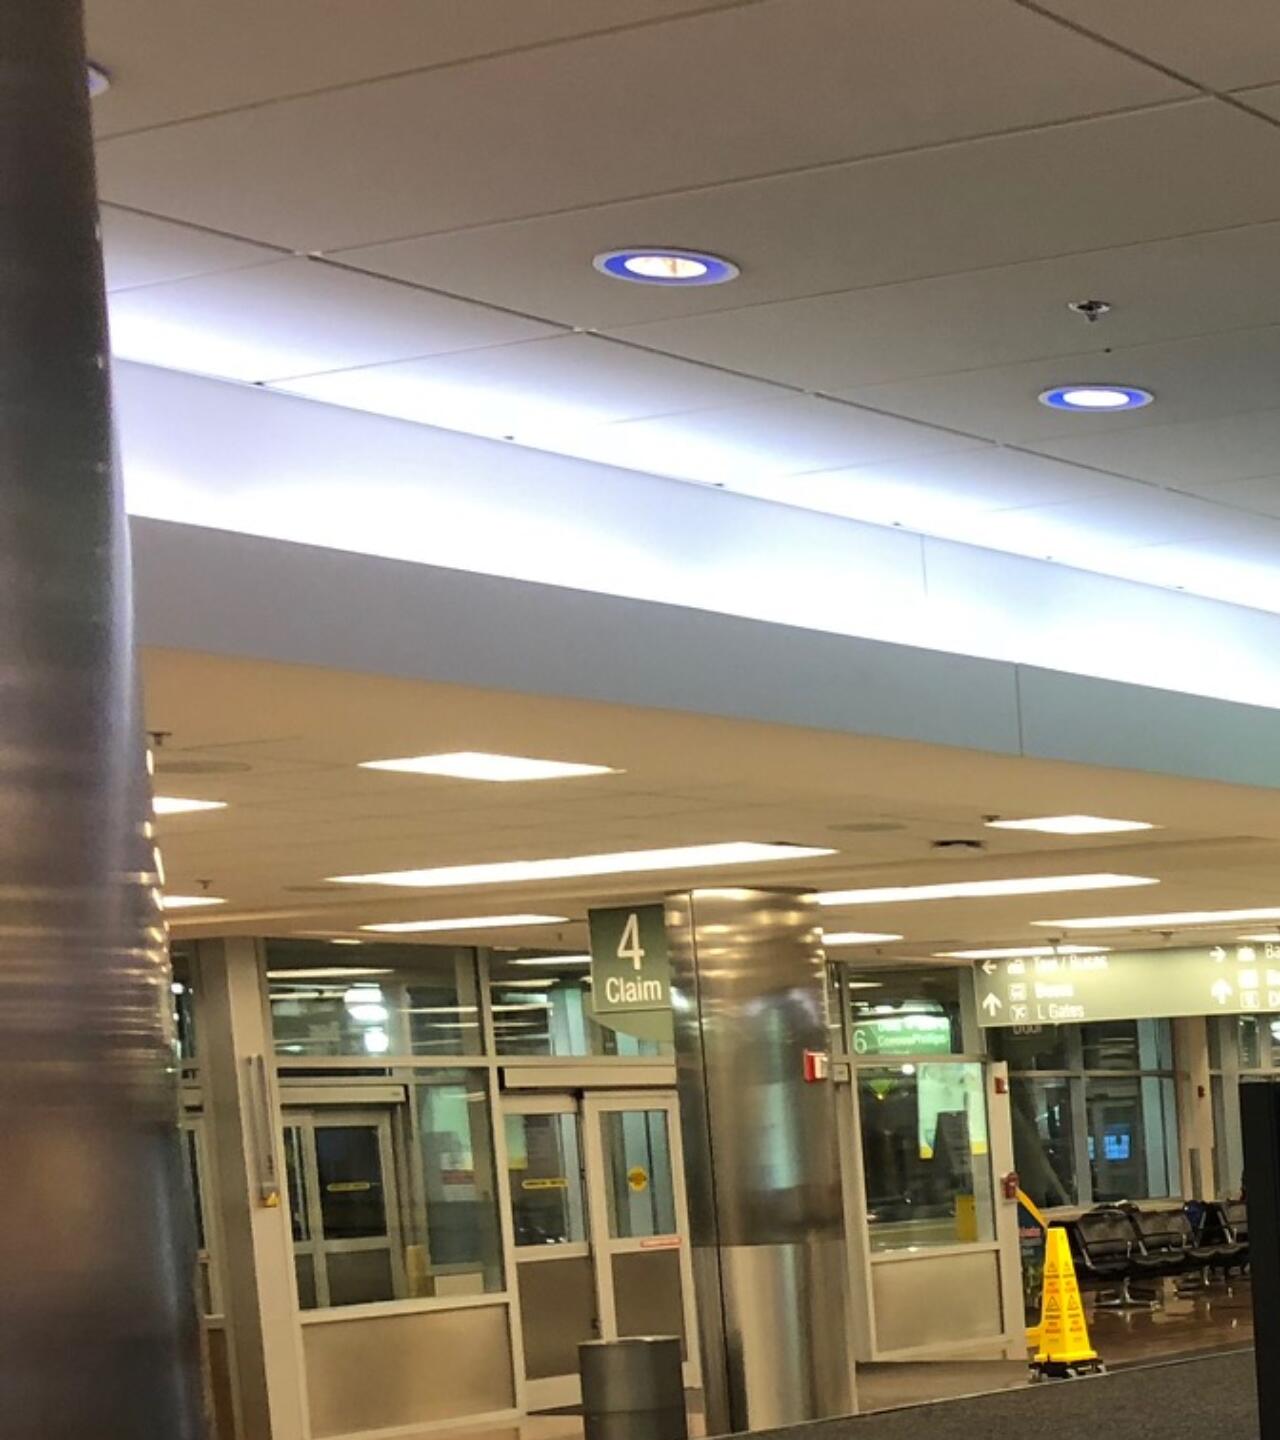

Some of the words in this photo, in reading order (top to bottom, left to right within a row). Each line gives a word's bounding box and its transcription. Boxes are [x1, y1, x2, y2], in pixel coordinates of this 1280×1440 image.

[616, 912, 645, 970] 4
[605, 976, 662, 1003] Claim
[1038, 1004, 1047, 1020] L
[1049, 1003, 1085, 1020] Gates
[853, 1030, 869, 1055] 6
